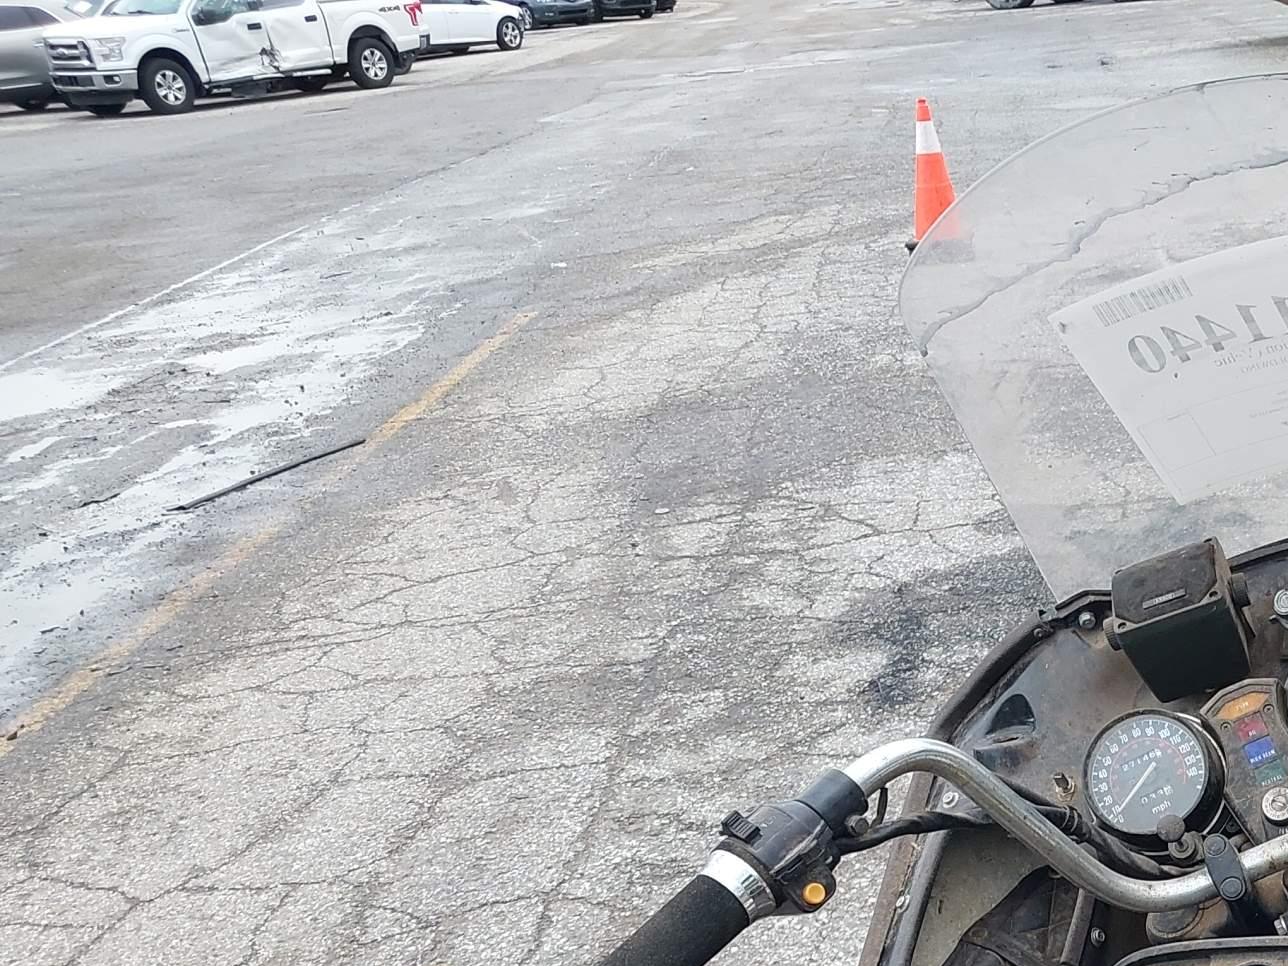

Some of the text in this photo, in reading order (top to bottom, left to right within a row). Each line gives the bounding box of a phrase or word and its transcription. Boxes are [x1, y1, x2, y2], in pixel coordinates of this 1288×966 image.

[1131, 728, 1142, 738] 80
[1144, 727, 1155, 737] 90
[1158, 728, 1171, 739] 100
[1119, 734, 1129, 744] 70
[1169, 735, 1182, 745] 110
[1109, 743, 1119, 753] 60
[1178, 743, 1191, 753] 120
[1102, 756, 1112, 766] 50
[1098, 768, 1108, 779] 40
[1099, 782, 1109, 792] 30
[1103, 795, 1113, 806] 20
[1151, 800, 1172, 815] mph
